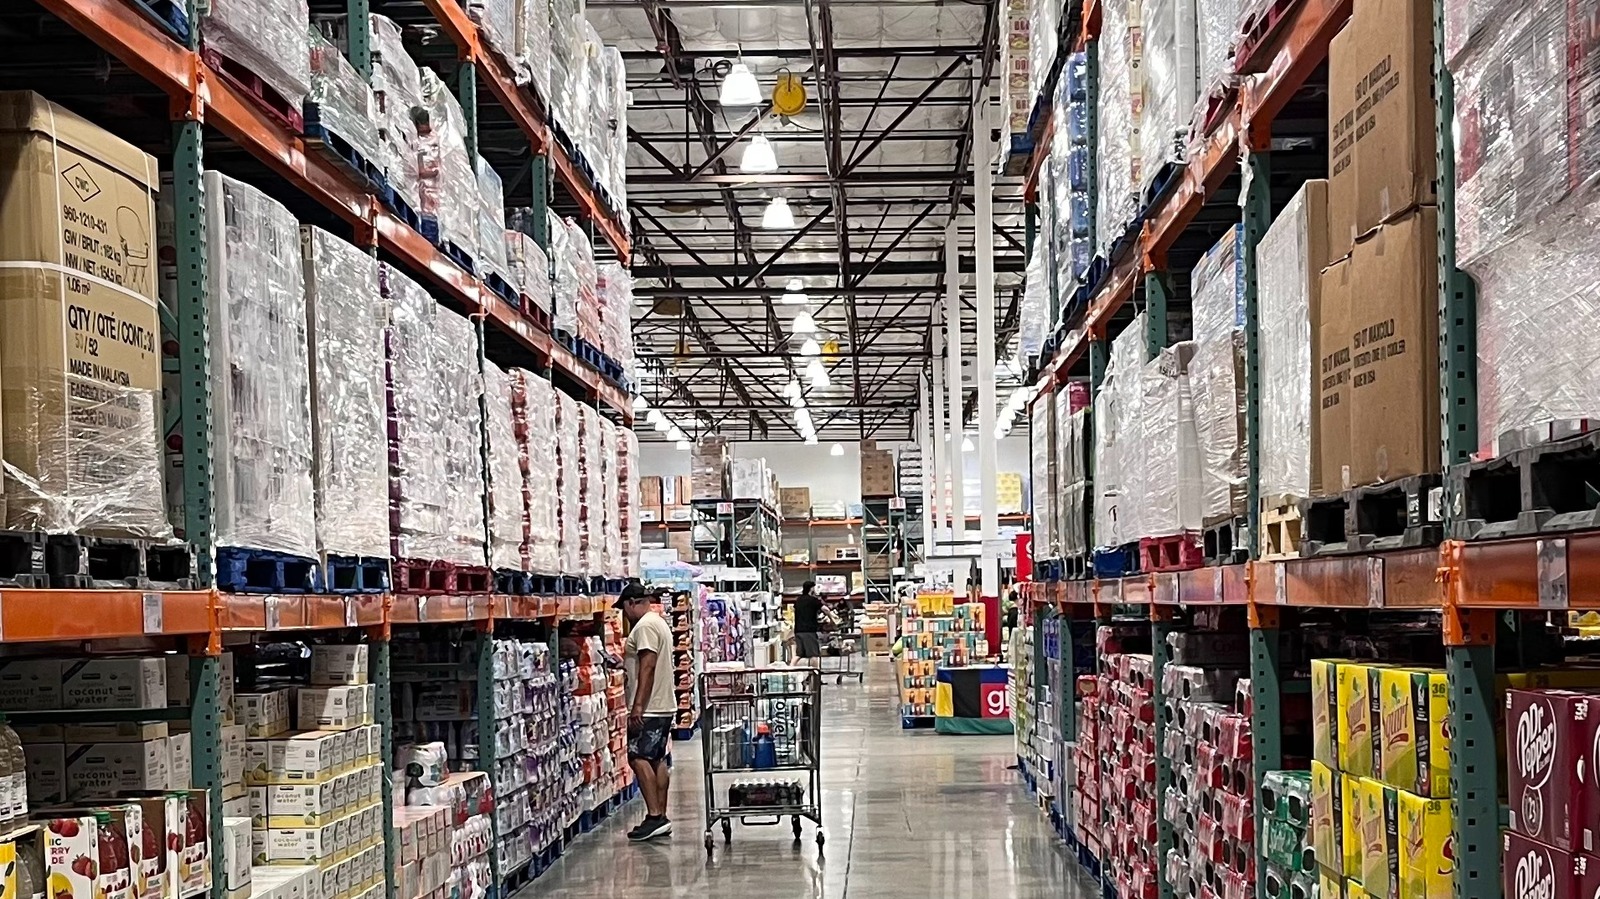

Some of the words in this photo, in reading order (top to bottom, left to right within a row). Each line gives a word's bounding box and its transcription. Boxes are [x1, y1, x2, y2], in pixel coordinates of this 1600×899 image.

[82, 234, 100, 255] BRUT
[67, 277, 80, 293] 1.06
[68, 304, 91, 332] QTY
[92, 311, 96, 334] /
[97, 311, 117, 340] QTÉ
[89, 337, 99, 357] 52
[70, 358, 92, 378] MADE
[93, 363, 100, 380] IN
[101, 366, 131, 387] MALAYSIA
[0, 687, 34, 696] oconut
[68, 687, 114, 696] coconut
[1432, 683, 1446, 694] 36
[75, 695, 108, 705] water
[1529, 702, 1544, 739] Dr
[1517, 711, 1554, 779] Pepper
[72, 770, 118, 780] coconut
[78, 779, 112, 788] water
[1427, 800, 1441, 811] 36
[50, 846, 71, 855] RRY
[51, 856, 65, 865] DE
[1527, 850, 1542, 889] Dr
